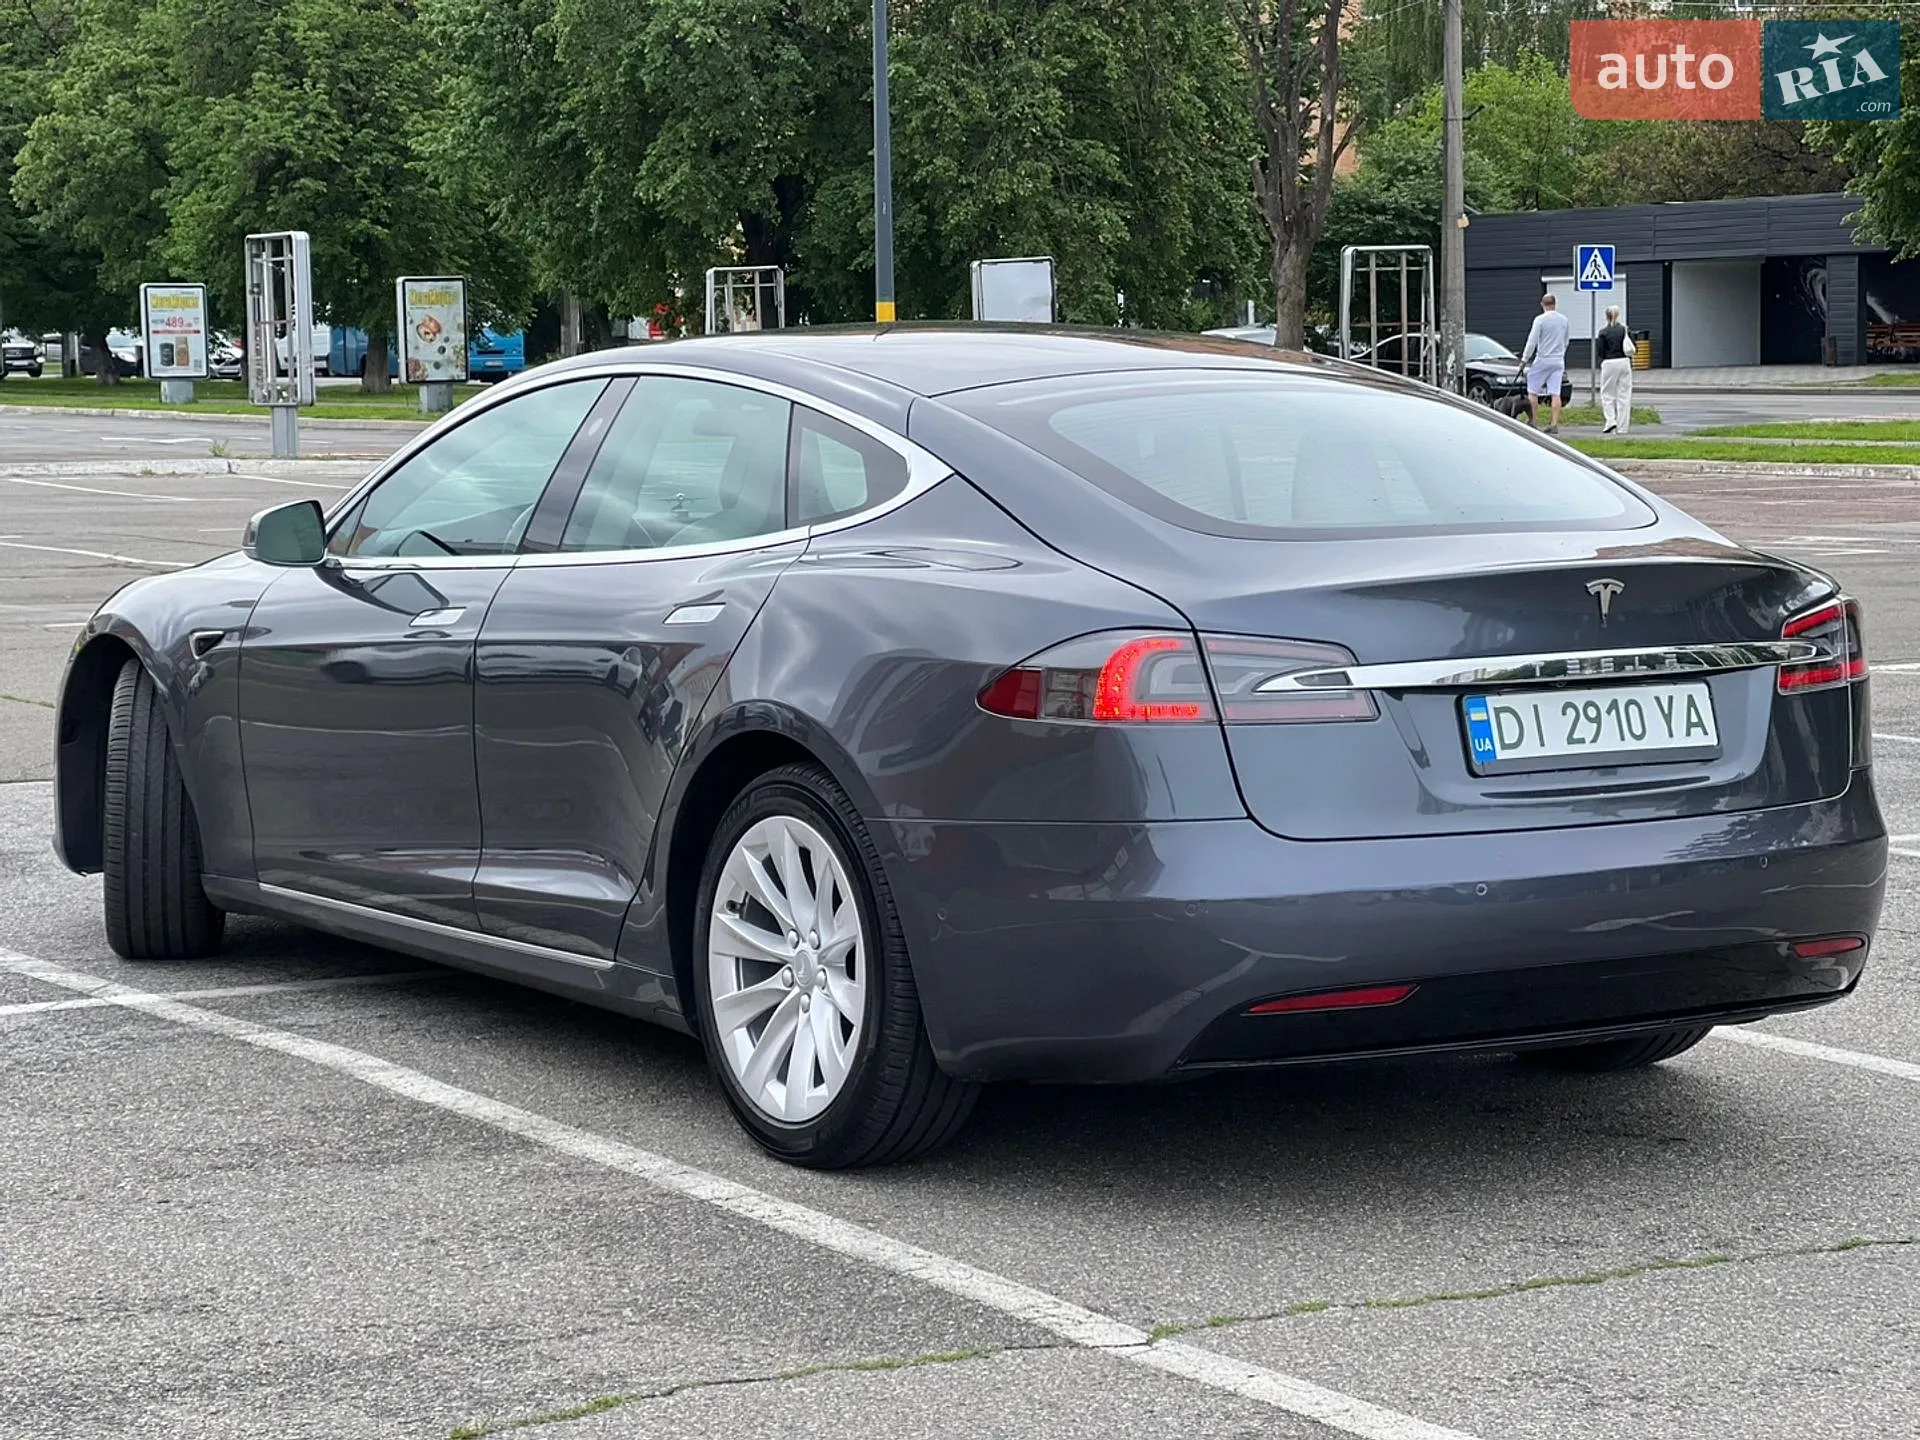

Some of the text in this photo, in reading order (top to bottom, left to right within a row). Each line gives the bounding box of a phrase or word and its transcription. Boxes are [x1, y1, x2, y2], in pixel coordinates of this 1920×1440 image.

[165, 316, 184, 328] 489
[1494, 693, 1710, 750] DI 2910 YA
[1474, 737, 1493, 752] UA
